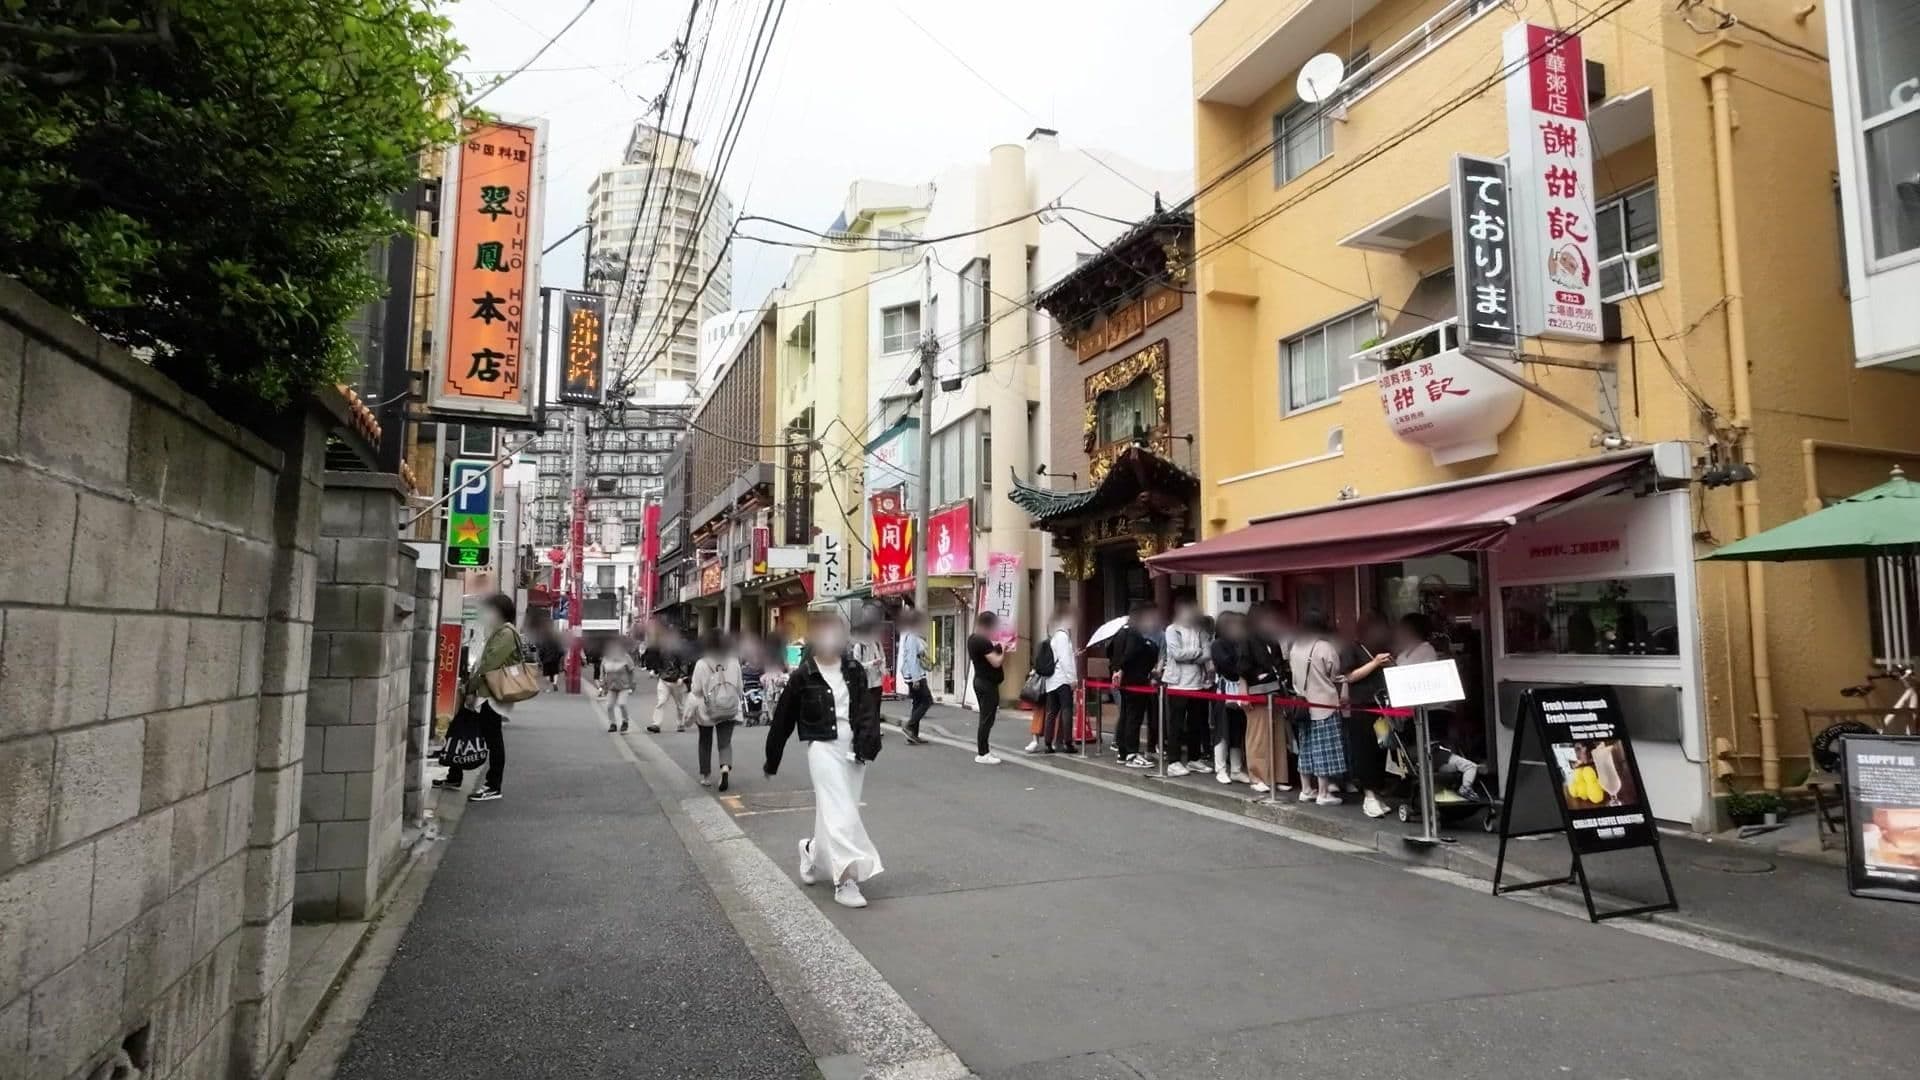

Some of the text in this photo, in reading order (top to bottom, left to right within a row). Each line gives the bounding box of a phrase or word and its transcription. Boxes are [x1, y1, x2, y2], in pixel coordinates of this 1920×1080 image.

[1545, 33, 1568, 114] 中華粥店
[468, 142, 527, 163] 中国料理
[1539, 120, 1588, 243] 謝甜記
[466, 185, 512, 383] 翠鳳本店
[1548, 304, 1593, 320] 工場直売所
[504, 288, 520, 384] HONTEN
[459, 468, 487, 510] P
